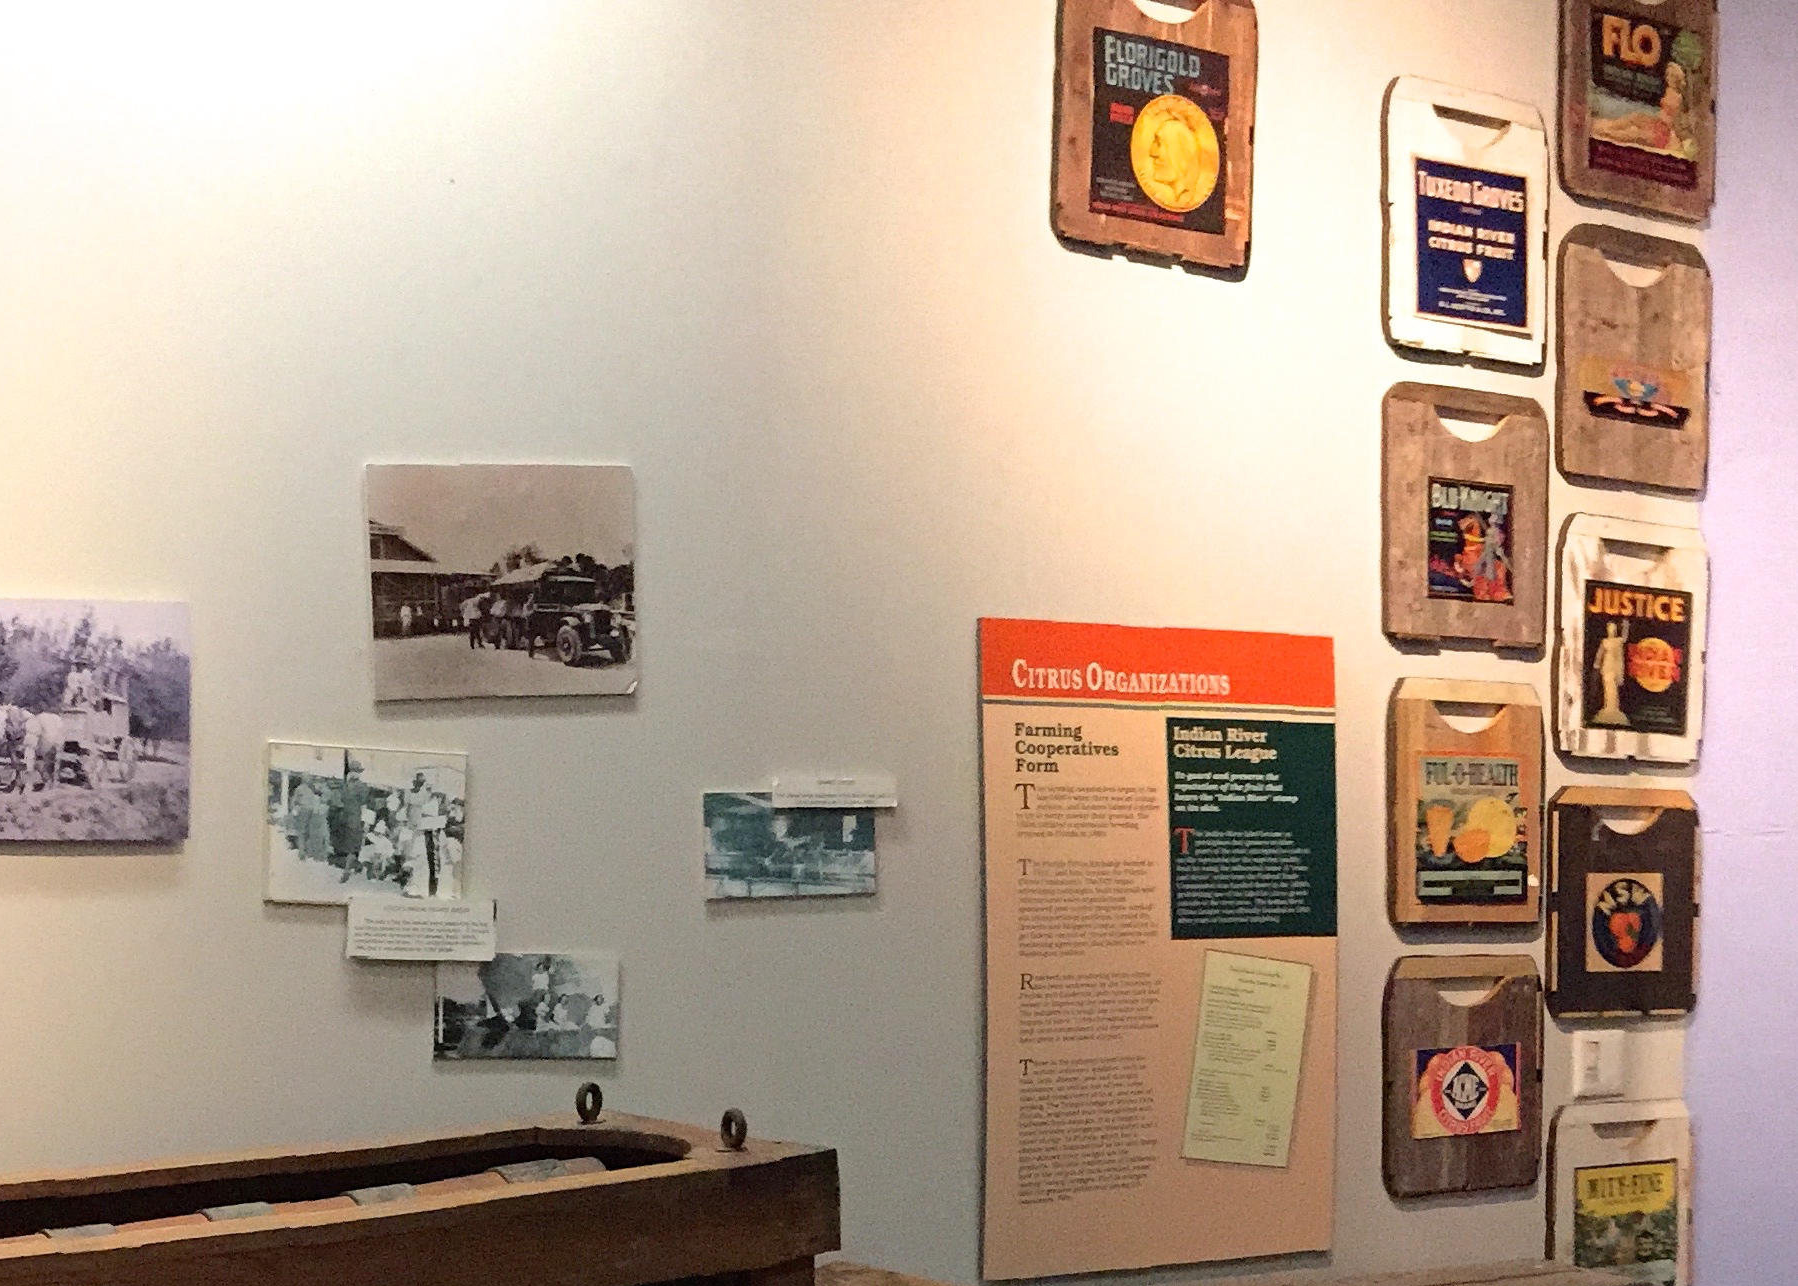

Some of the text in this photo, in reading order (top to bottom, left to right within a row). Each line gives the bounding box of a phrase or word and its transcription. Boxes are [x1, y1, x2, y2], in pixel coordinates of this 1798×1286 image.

[1602, 14, 1661, 67] FLO
[1105, 35, 1200, 78] FLORIGOLD
[1105, 63, 1174, 94] GROVES
[1418, 170, 1524, 212] TUXEDO GROVES
[1588, 587, 1685, 622] JUSTICE
[1012, 658, 1230, 696] CITRUS ORGANIZATIONS
[1015, 723, 1082, 741] Farming
[1173, 726, 1268, 744] Indian River
[1015, 741, 1119, 758] Cooperatives
[1173, 744, 1277, 764] Citrus League
[1015, 759, 1059, 773] Form
